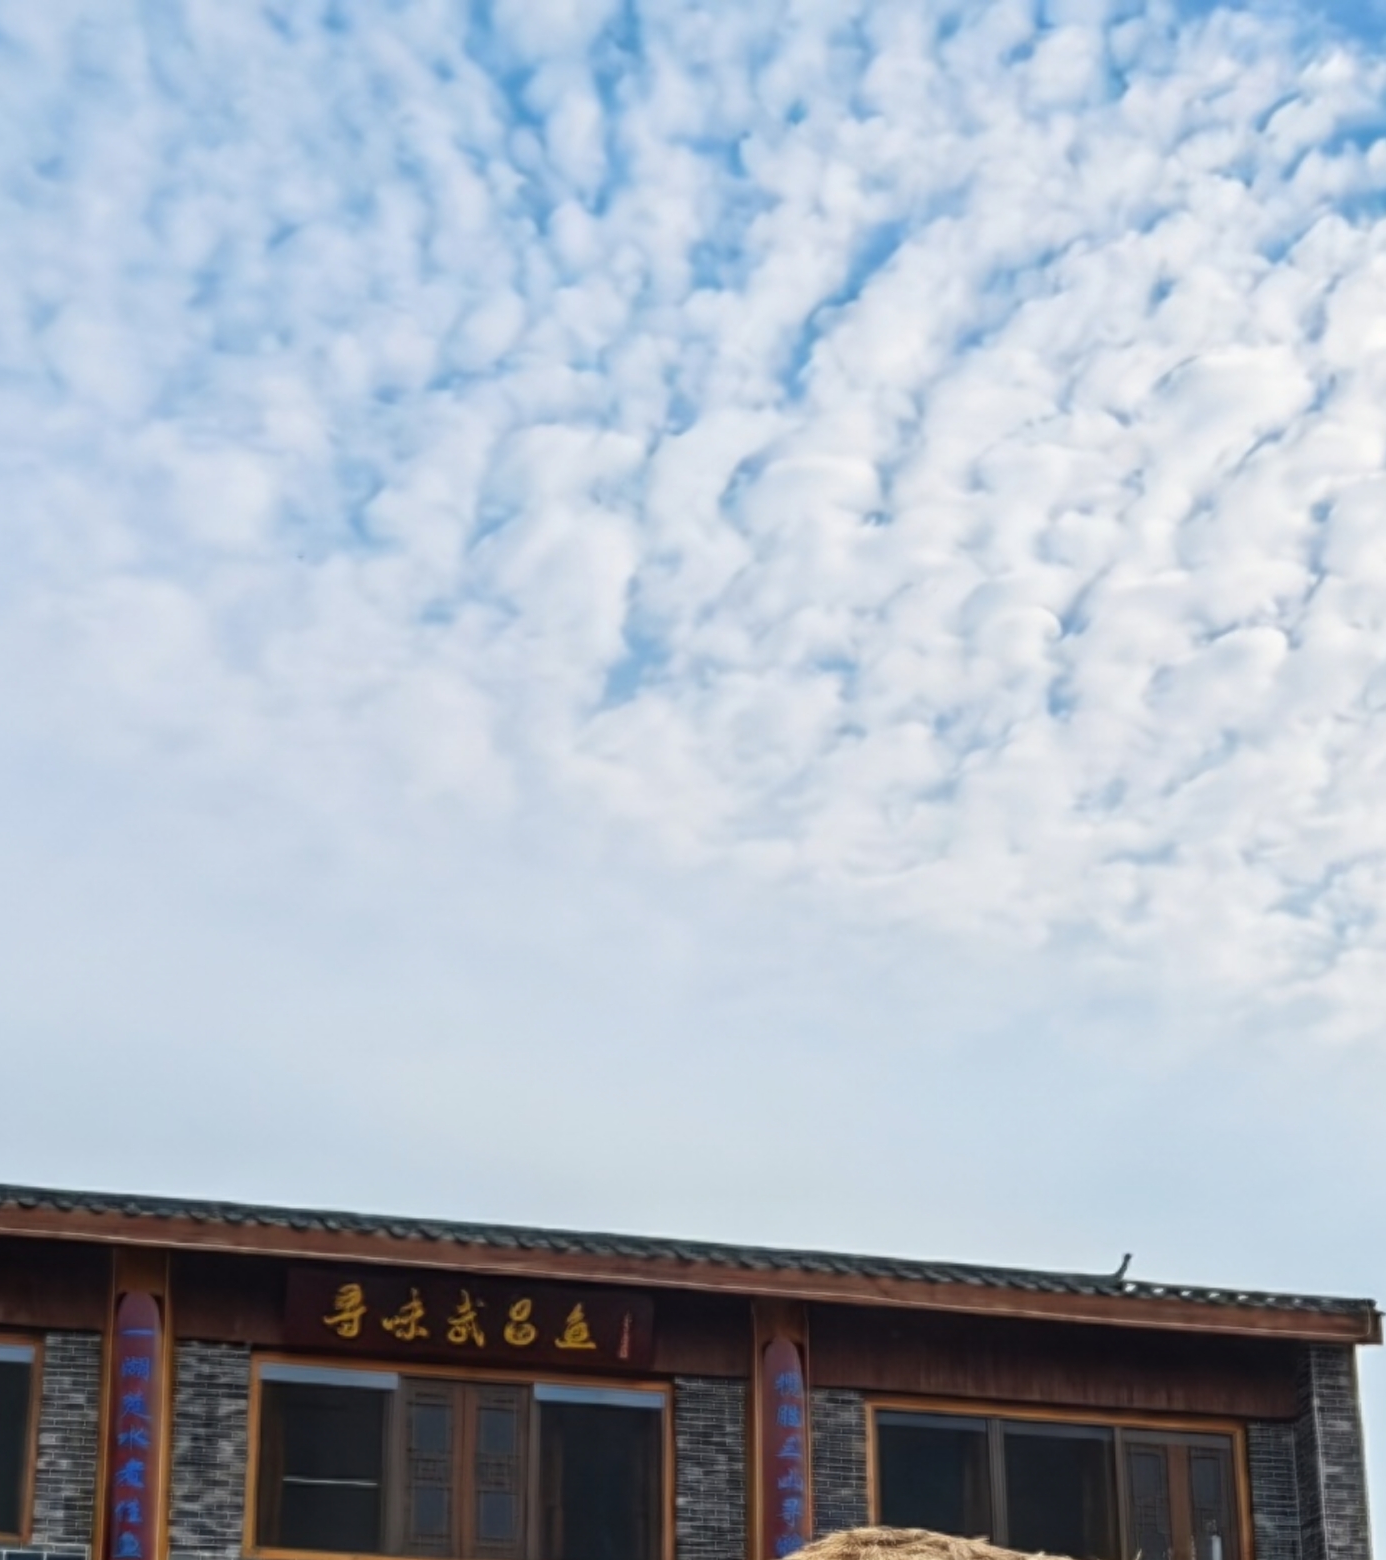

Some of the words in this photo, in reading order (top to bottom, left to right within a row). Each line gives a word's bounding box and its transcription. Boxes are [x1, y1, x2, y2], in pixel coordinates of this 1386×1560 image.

[324, 1283, 597, 1349] 寻味武昌鱼
